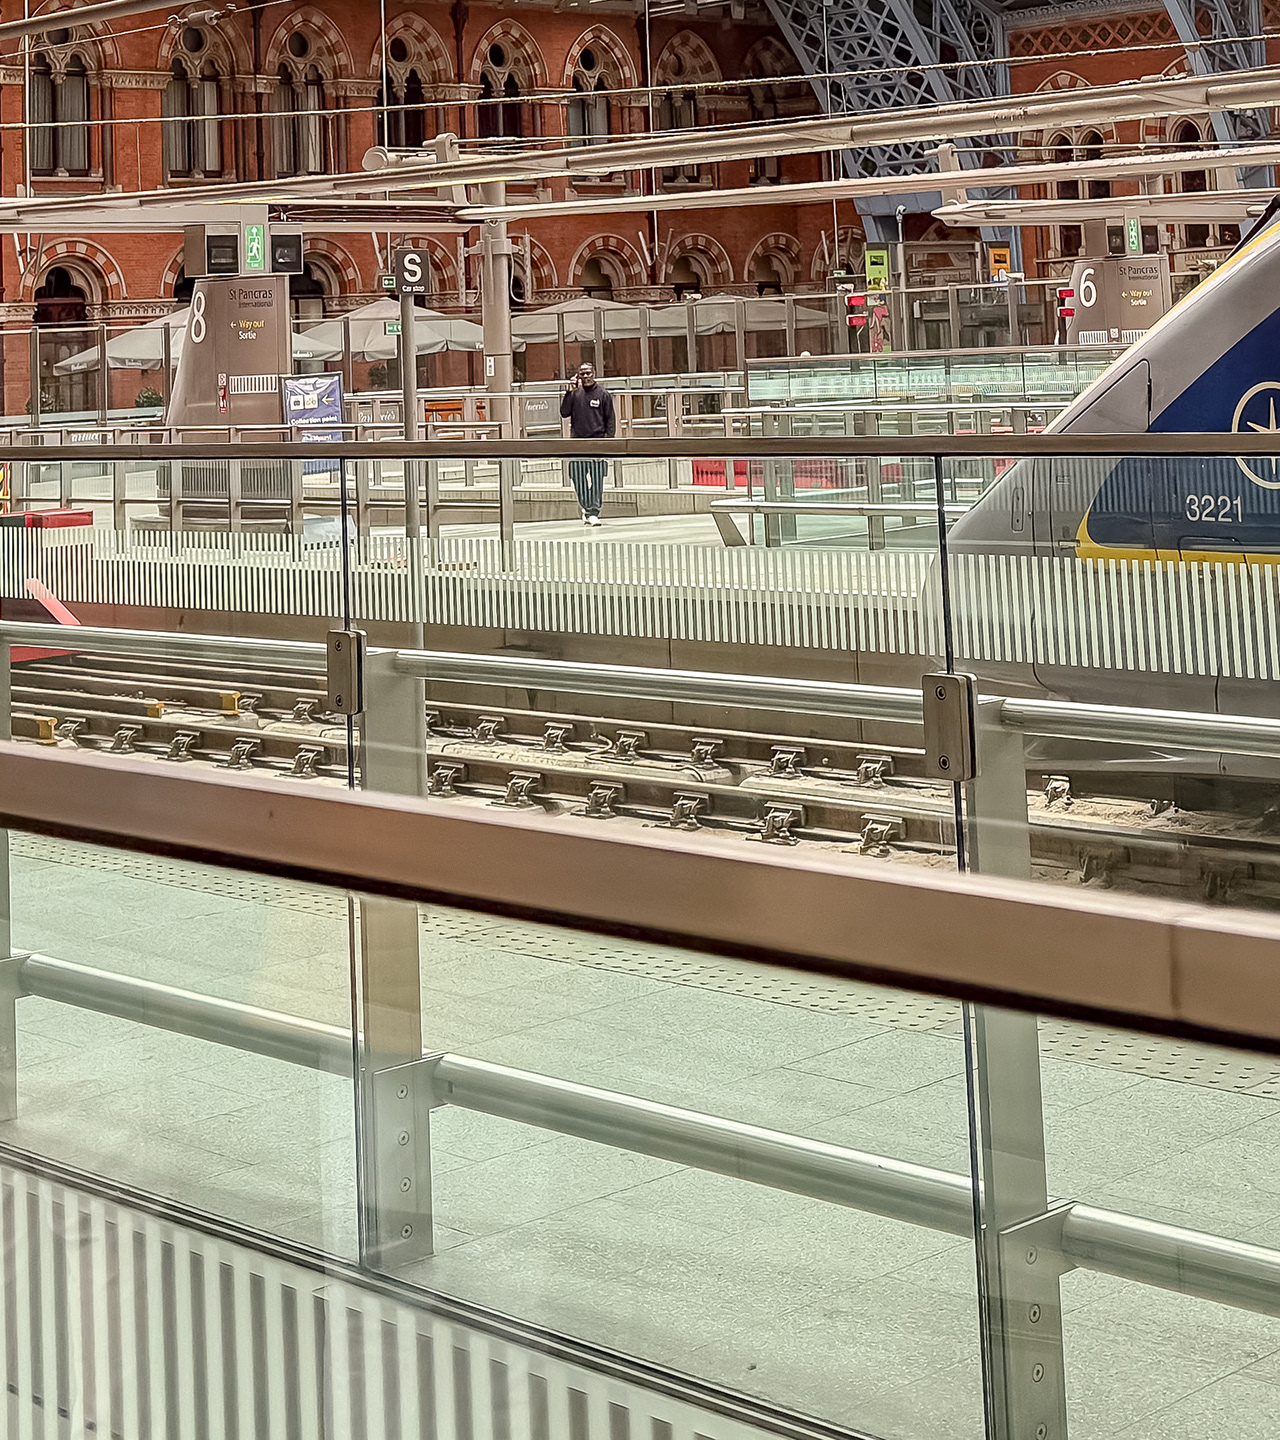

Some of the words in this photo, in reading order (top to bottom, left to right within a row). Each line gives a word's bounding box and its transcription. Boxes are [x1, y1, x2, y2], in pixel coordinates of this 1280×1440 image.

[403, 253, 422, 283] S
[1119, 266, 1127, 276] St
[1128, 265, 1158, 276] Pancras
[229, 288, 237, 300] St
[238, 288, 273, 300] Pancras
[1079, 268, 1097, 308] 6
[191, 291, 207, 344] 8
[239, 320, 253, 329] Way
[253, 320, 265, 328] out
[239, 331, 257, 340] Sortie
[1186, 494, 1242, 523] 3221
